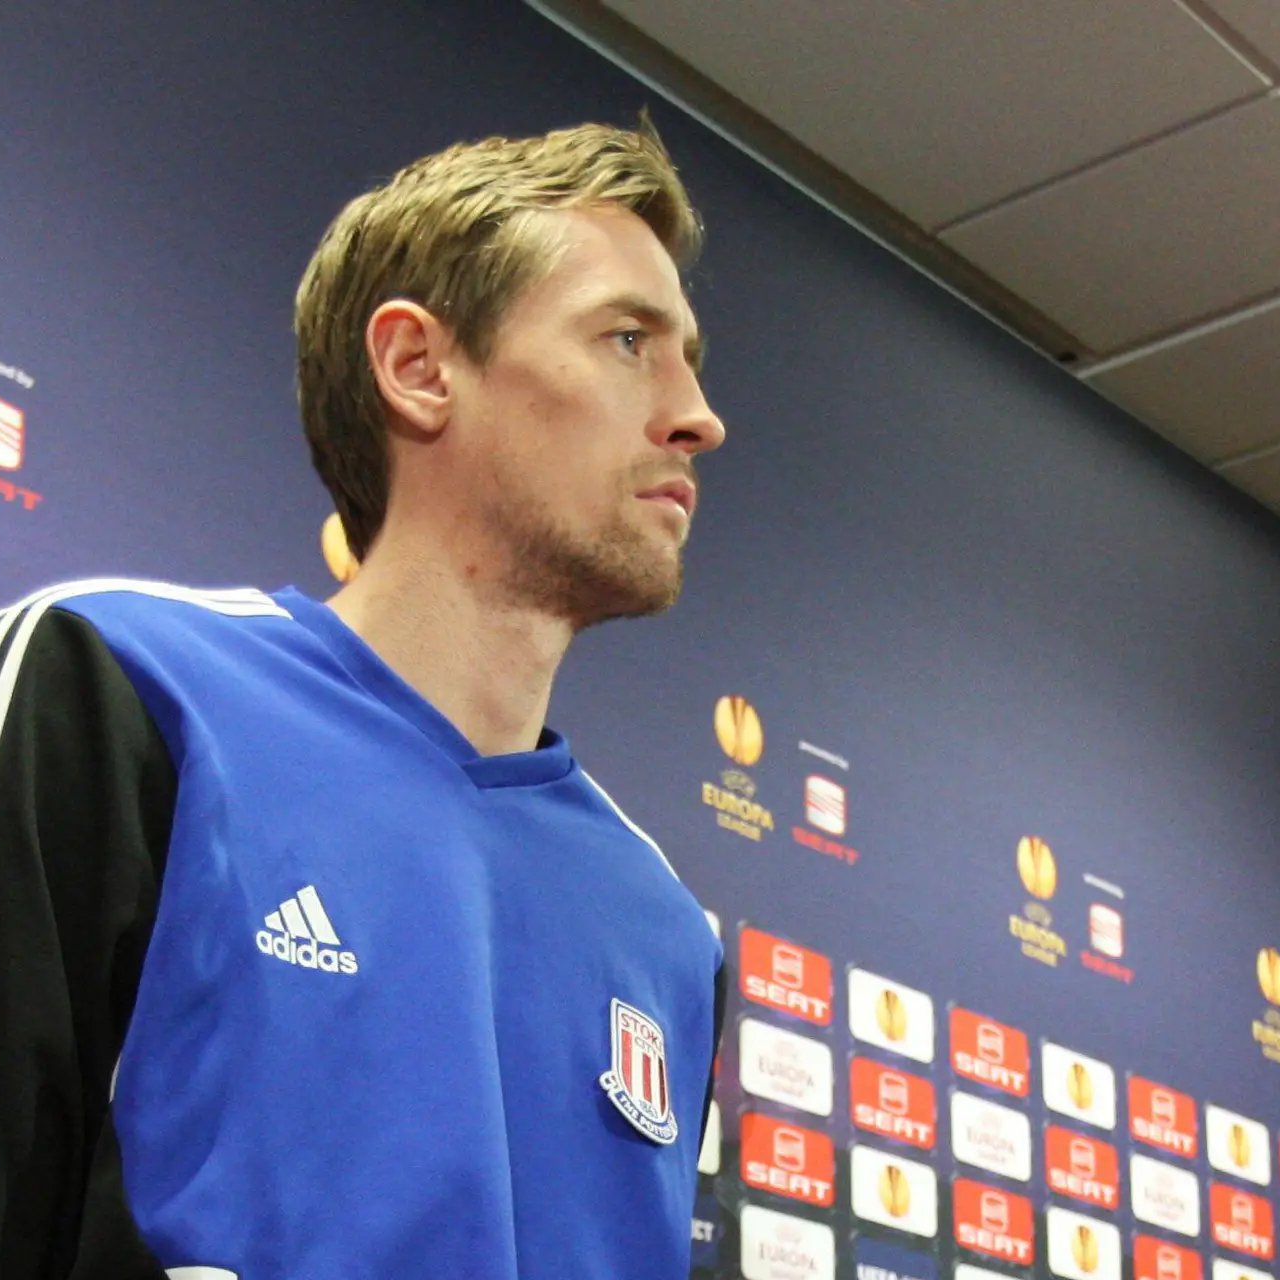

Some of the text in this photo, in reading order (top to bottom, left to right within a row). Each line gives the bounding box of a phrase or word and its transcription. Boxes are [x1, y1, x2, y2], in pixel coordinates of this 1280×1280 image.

[256, 926, 358, 975] adidas
[745, 975, 829, 1019] SEAT
[956, 1050, 1024, 1092] SEAT
[854, 1103, 932, 1144] SEAT
[1133, 1116, 1194, 1154] SEAT
[746, 1161, 832, 1200] SEAT
[1050, 1167, 1117, 1205] SEAT
[959, 1223, 1030, 1260] SEAT
[1215, 1224, 1272, 1255] SEAT
